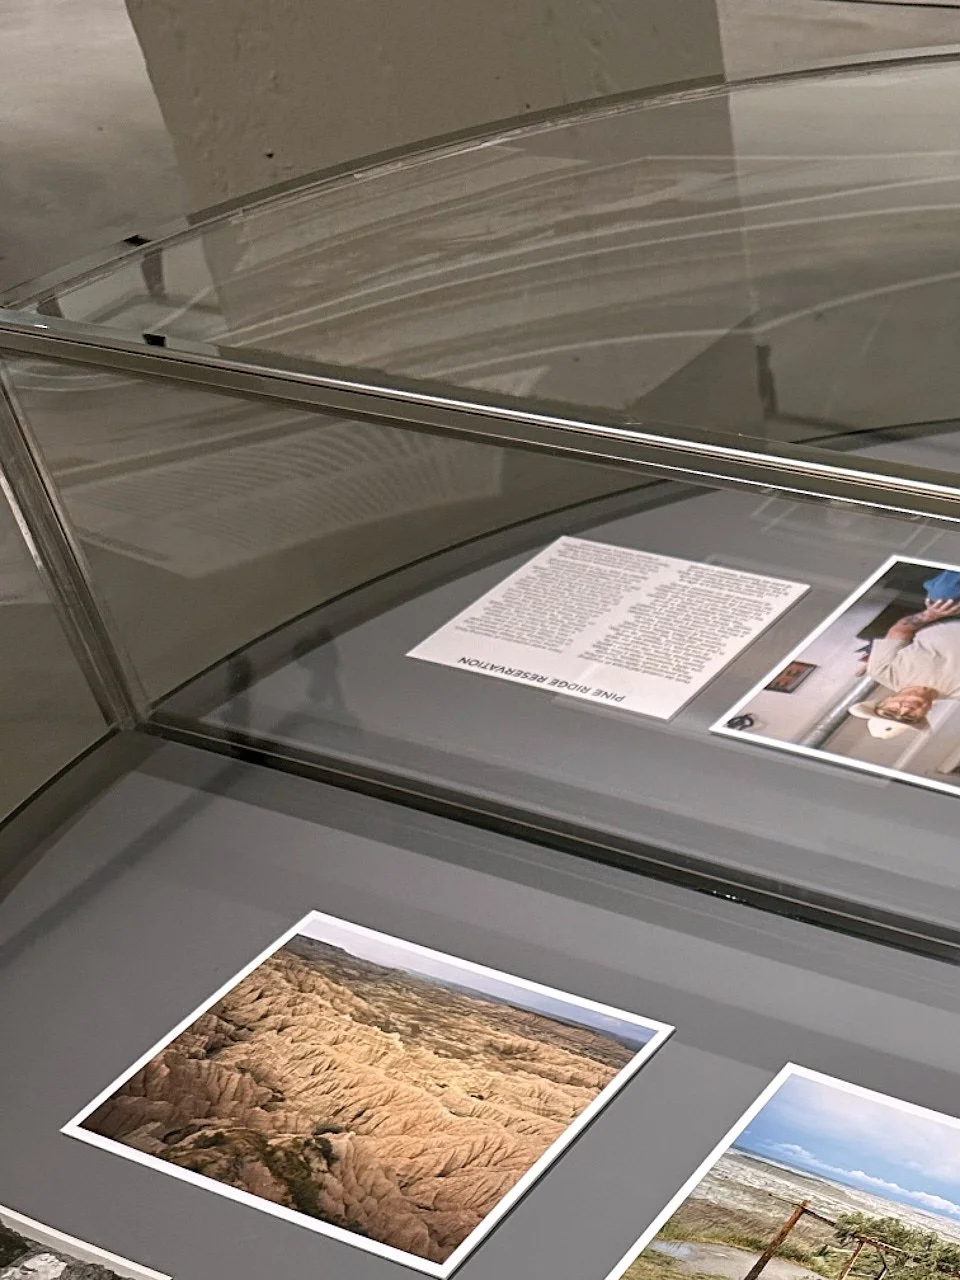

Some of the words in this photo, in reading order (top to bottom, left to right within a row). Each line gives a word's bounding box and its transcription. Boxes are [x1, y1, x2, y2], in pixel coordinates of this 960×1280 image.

[458, 656, 550, 683] RESERVATION
[549, 678, 591, 694] RIDGE
[594, 688, 626, 702] PINE
